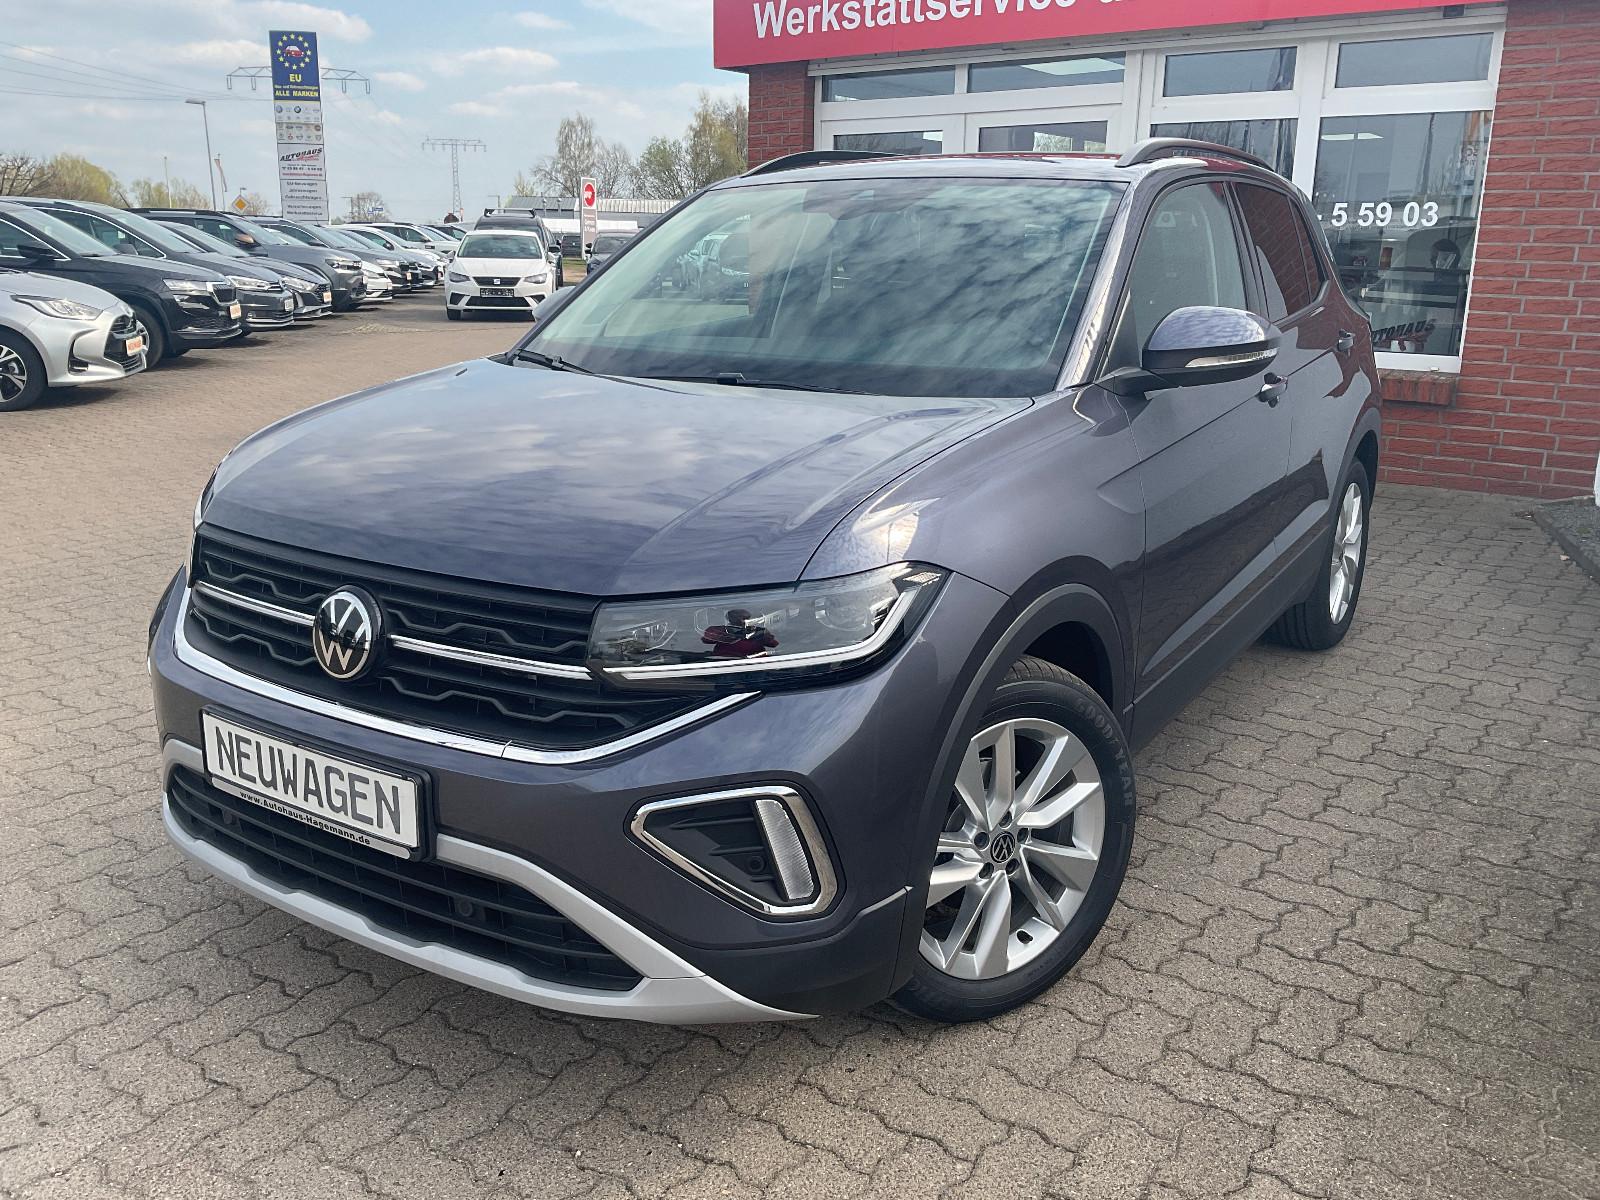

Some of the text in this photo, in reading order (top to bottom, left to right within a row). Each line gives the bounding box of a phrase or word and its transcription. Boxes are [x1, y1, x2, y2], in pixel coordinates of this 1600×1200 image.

[289, 73, 302, 82] EU
[280, 147, 323, 161] AUTOHAUS
[1331, 201, 1439, 227] 5 59 03
[215, 726, 401, 835] NEUWAGEN
[239, 790, 371, 846] www.Autohaus-Hagemann.de
